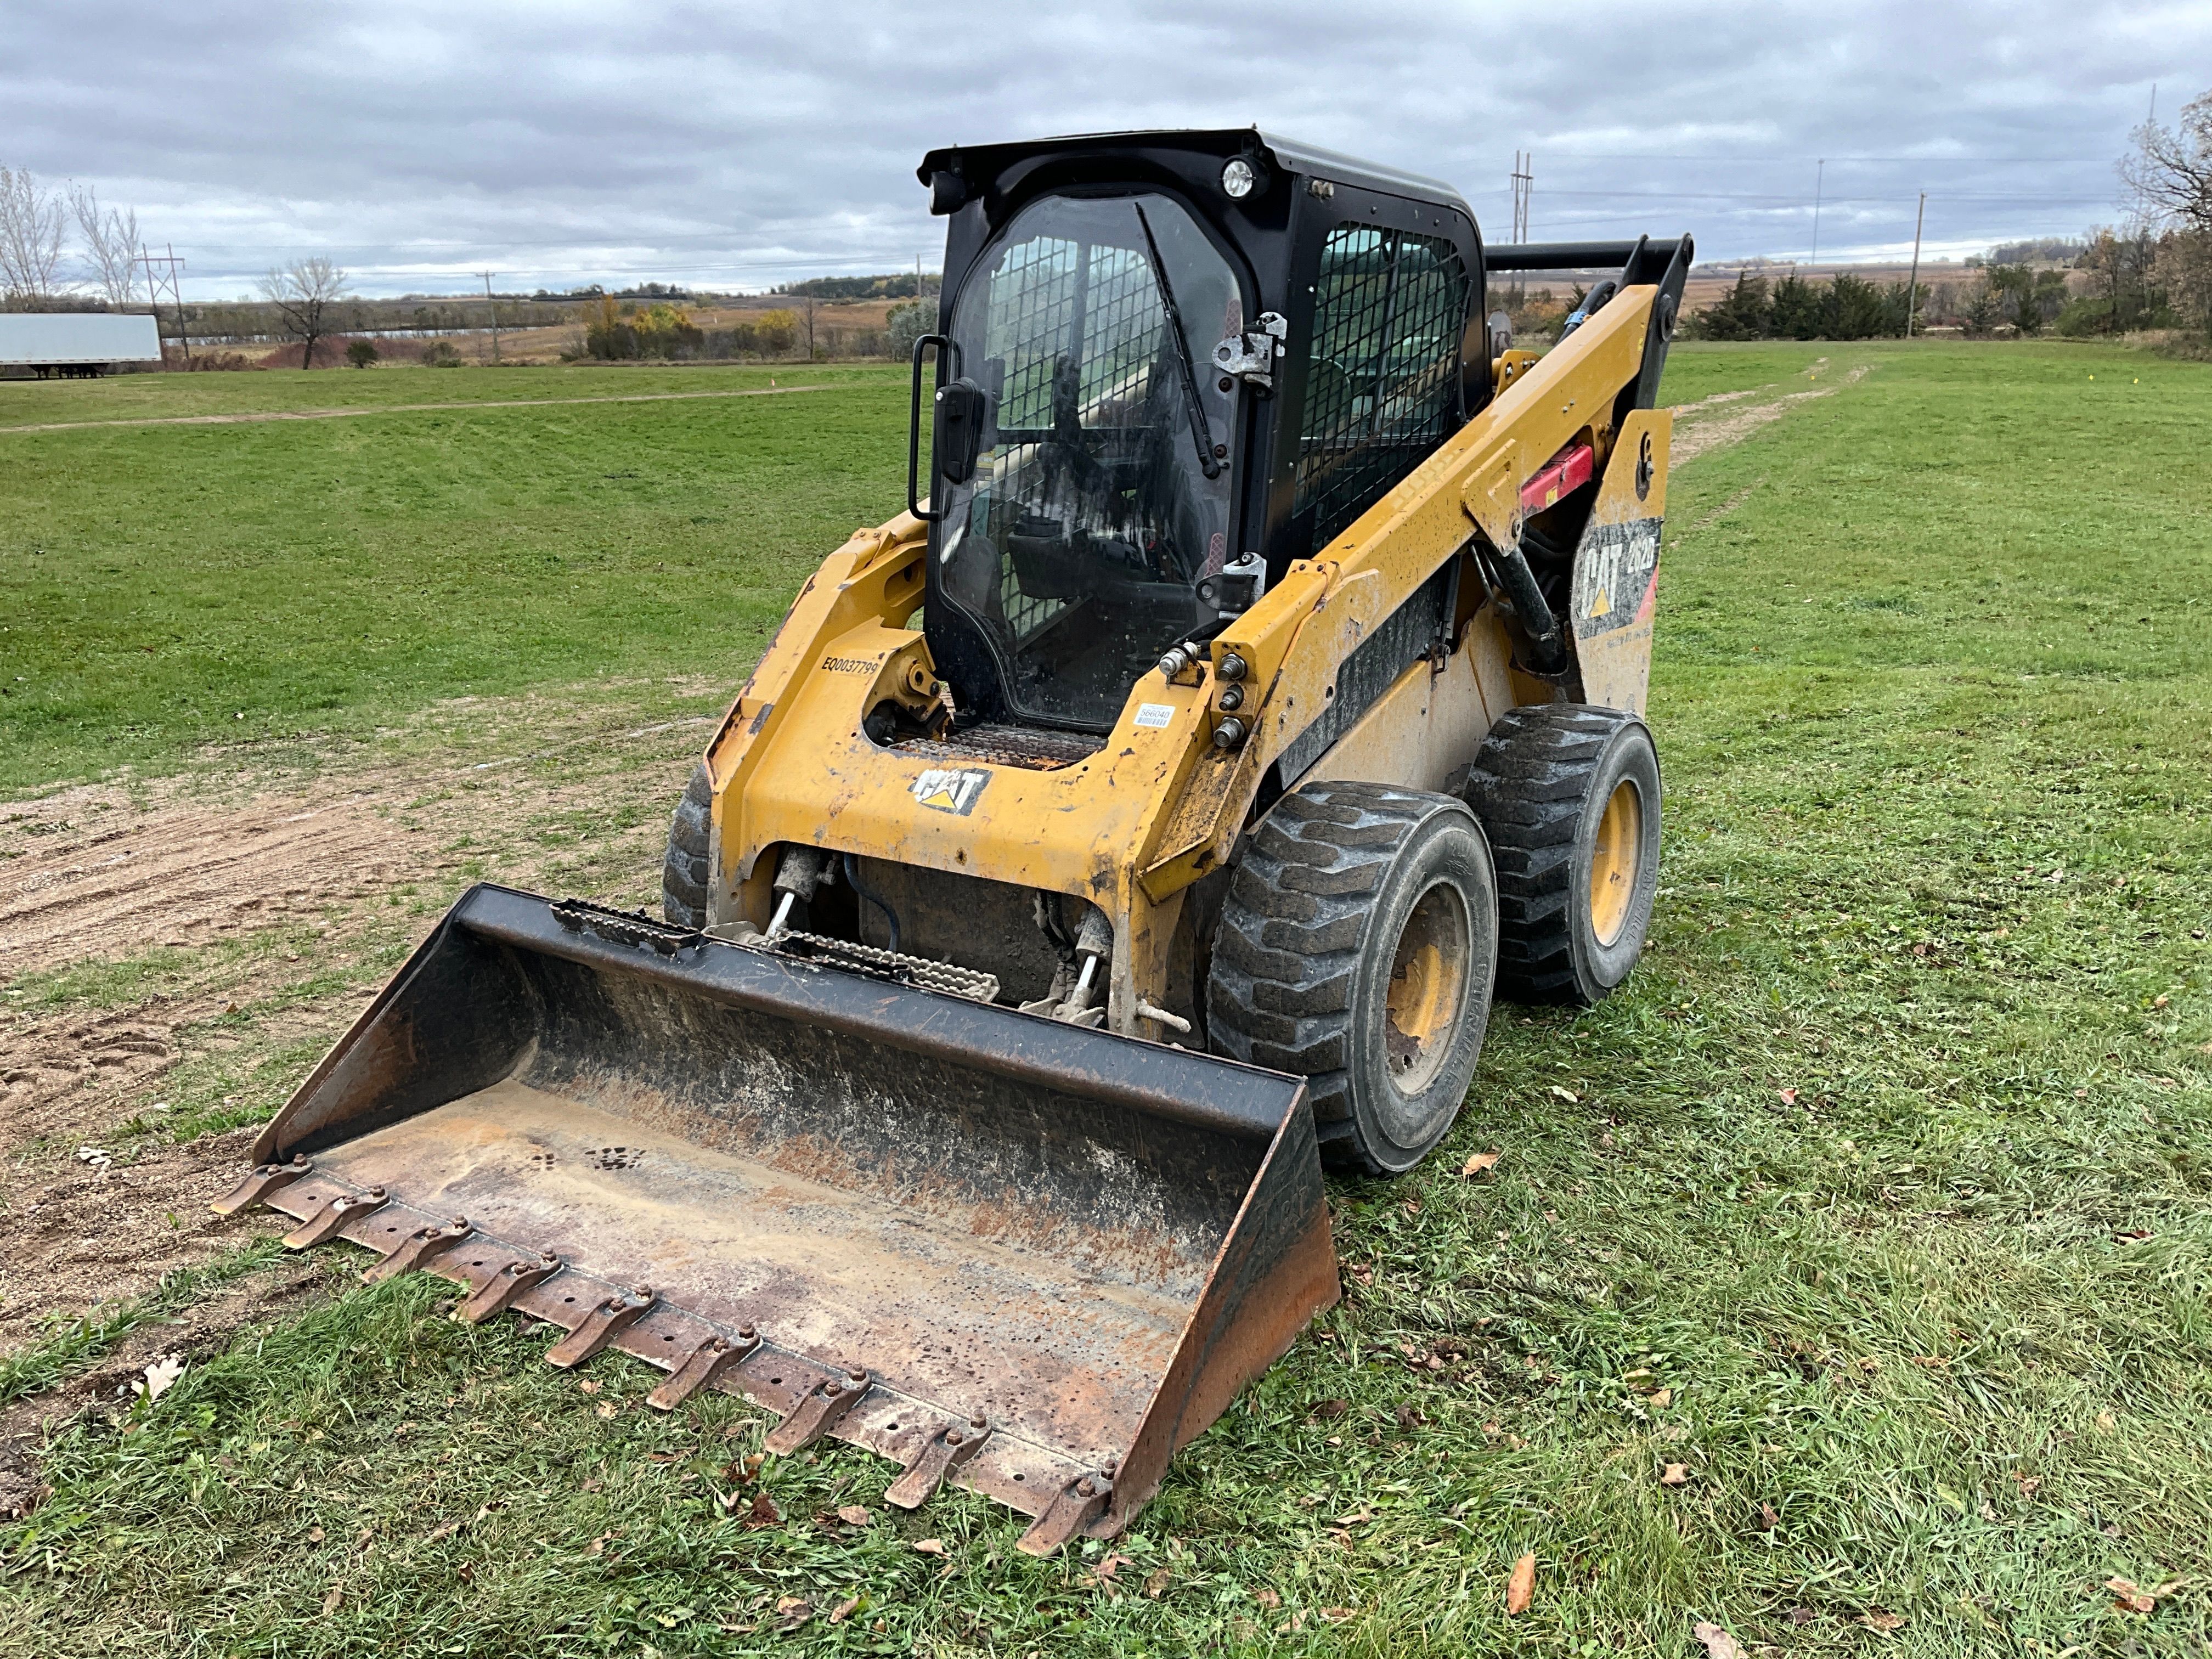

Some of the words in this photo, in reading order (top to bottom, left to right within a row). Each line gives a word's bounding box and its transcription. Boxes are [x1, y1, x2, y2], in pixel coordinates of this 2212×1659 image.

[1581, 543, 1623, 620] CAT
[822, 657, 879, 675] EQ0037799
[1141, 709, 1170, 719] 566040
[912, 769, 984, 810] CAT
